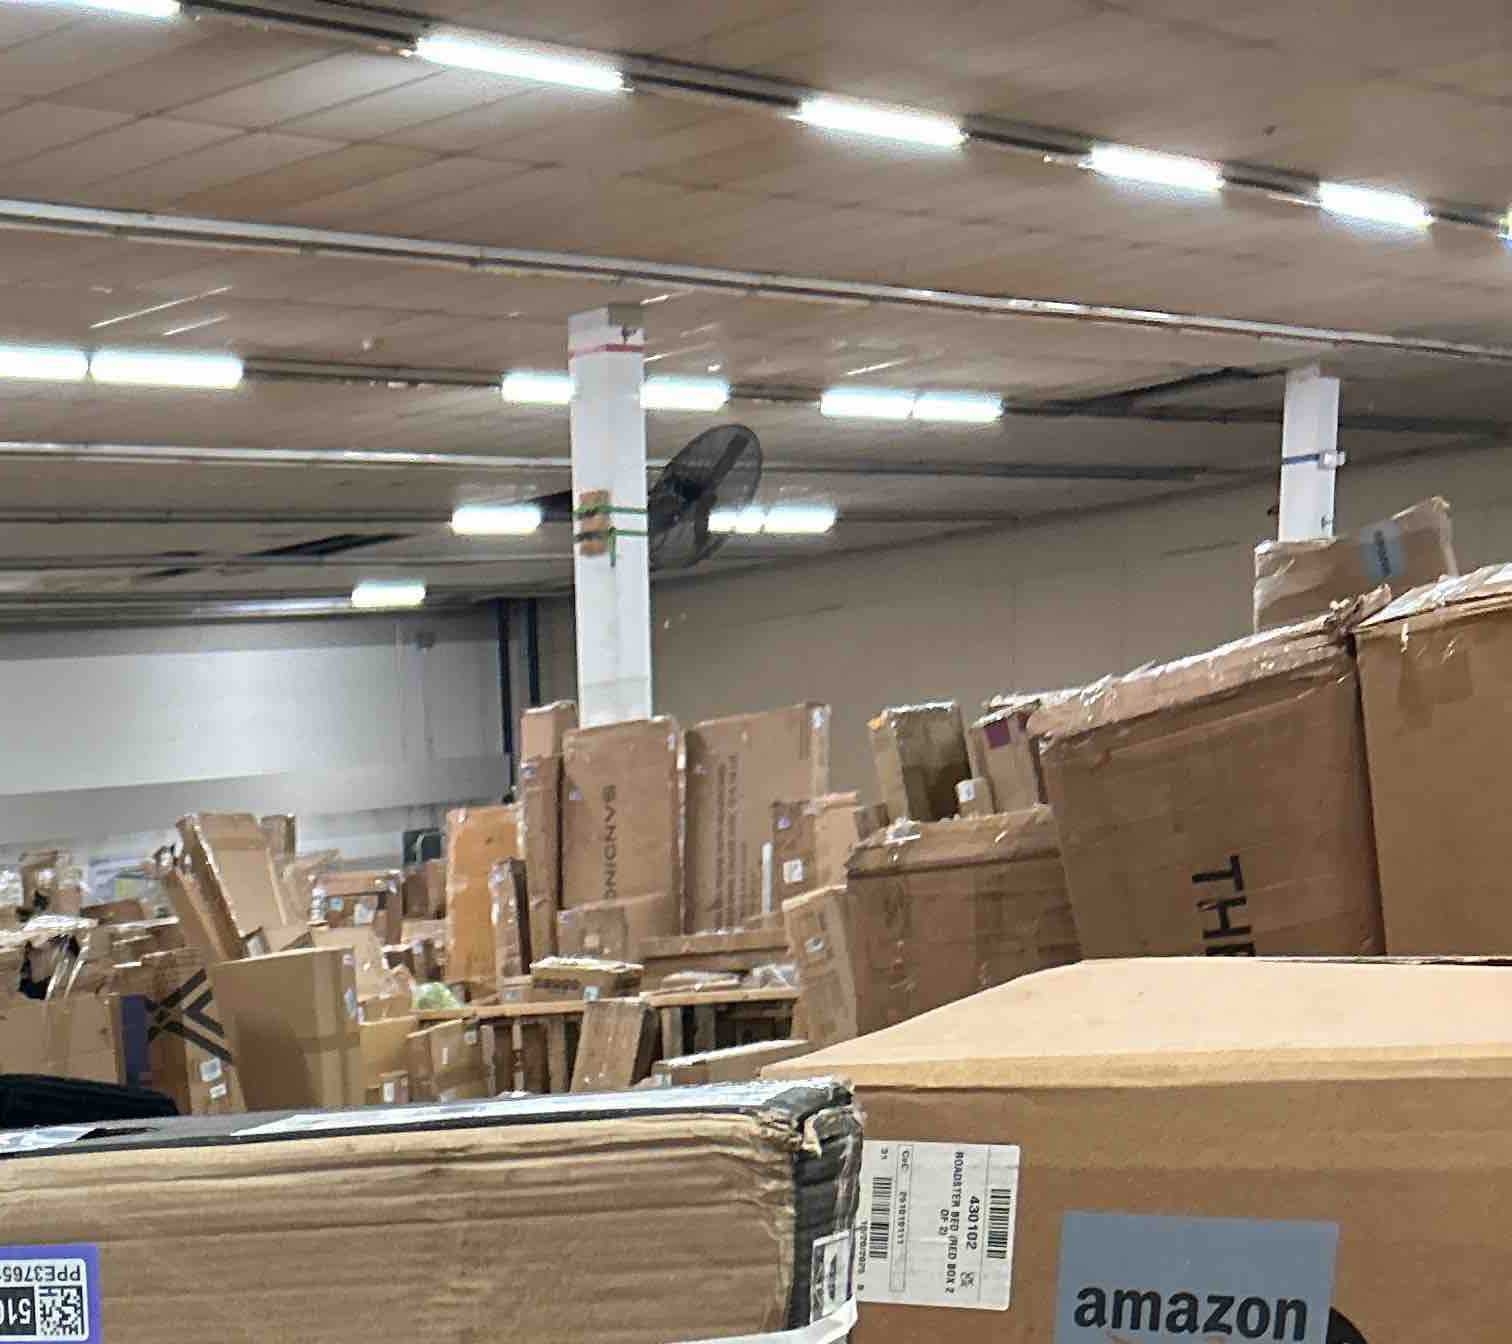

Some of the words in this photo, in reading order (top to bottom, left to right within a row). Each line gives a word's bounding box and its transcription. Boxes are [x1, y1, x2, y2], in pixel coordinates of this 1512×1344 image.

[951, 1151, 964, 1208] ROADSTER
[940, 1208, 950, 1222] OF
[950, 1211, 960, 1232] BED
[966, 1195, 980, 1250] 430102
[945, 1263, 957, 1283] BOX
[1074, 1286, 1309, 1342] amazon
